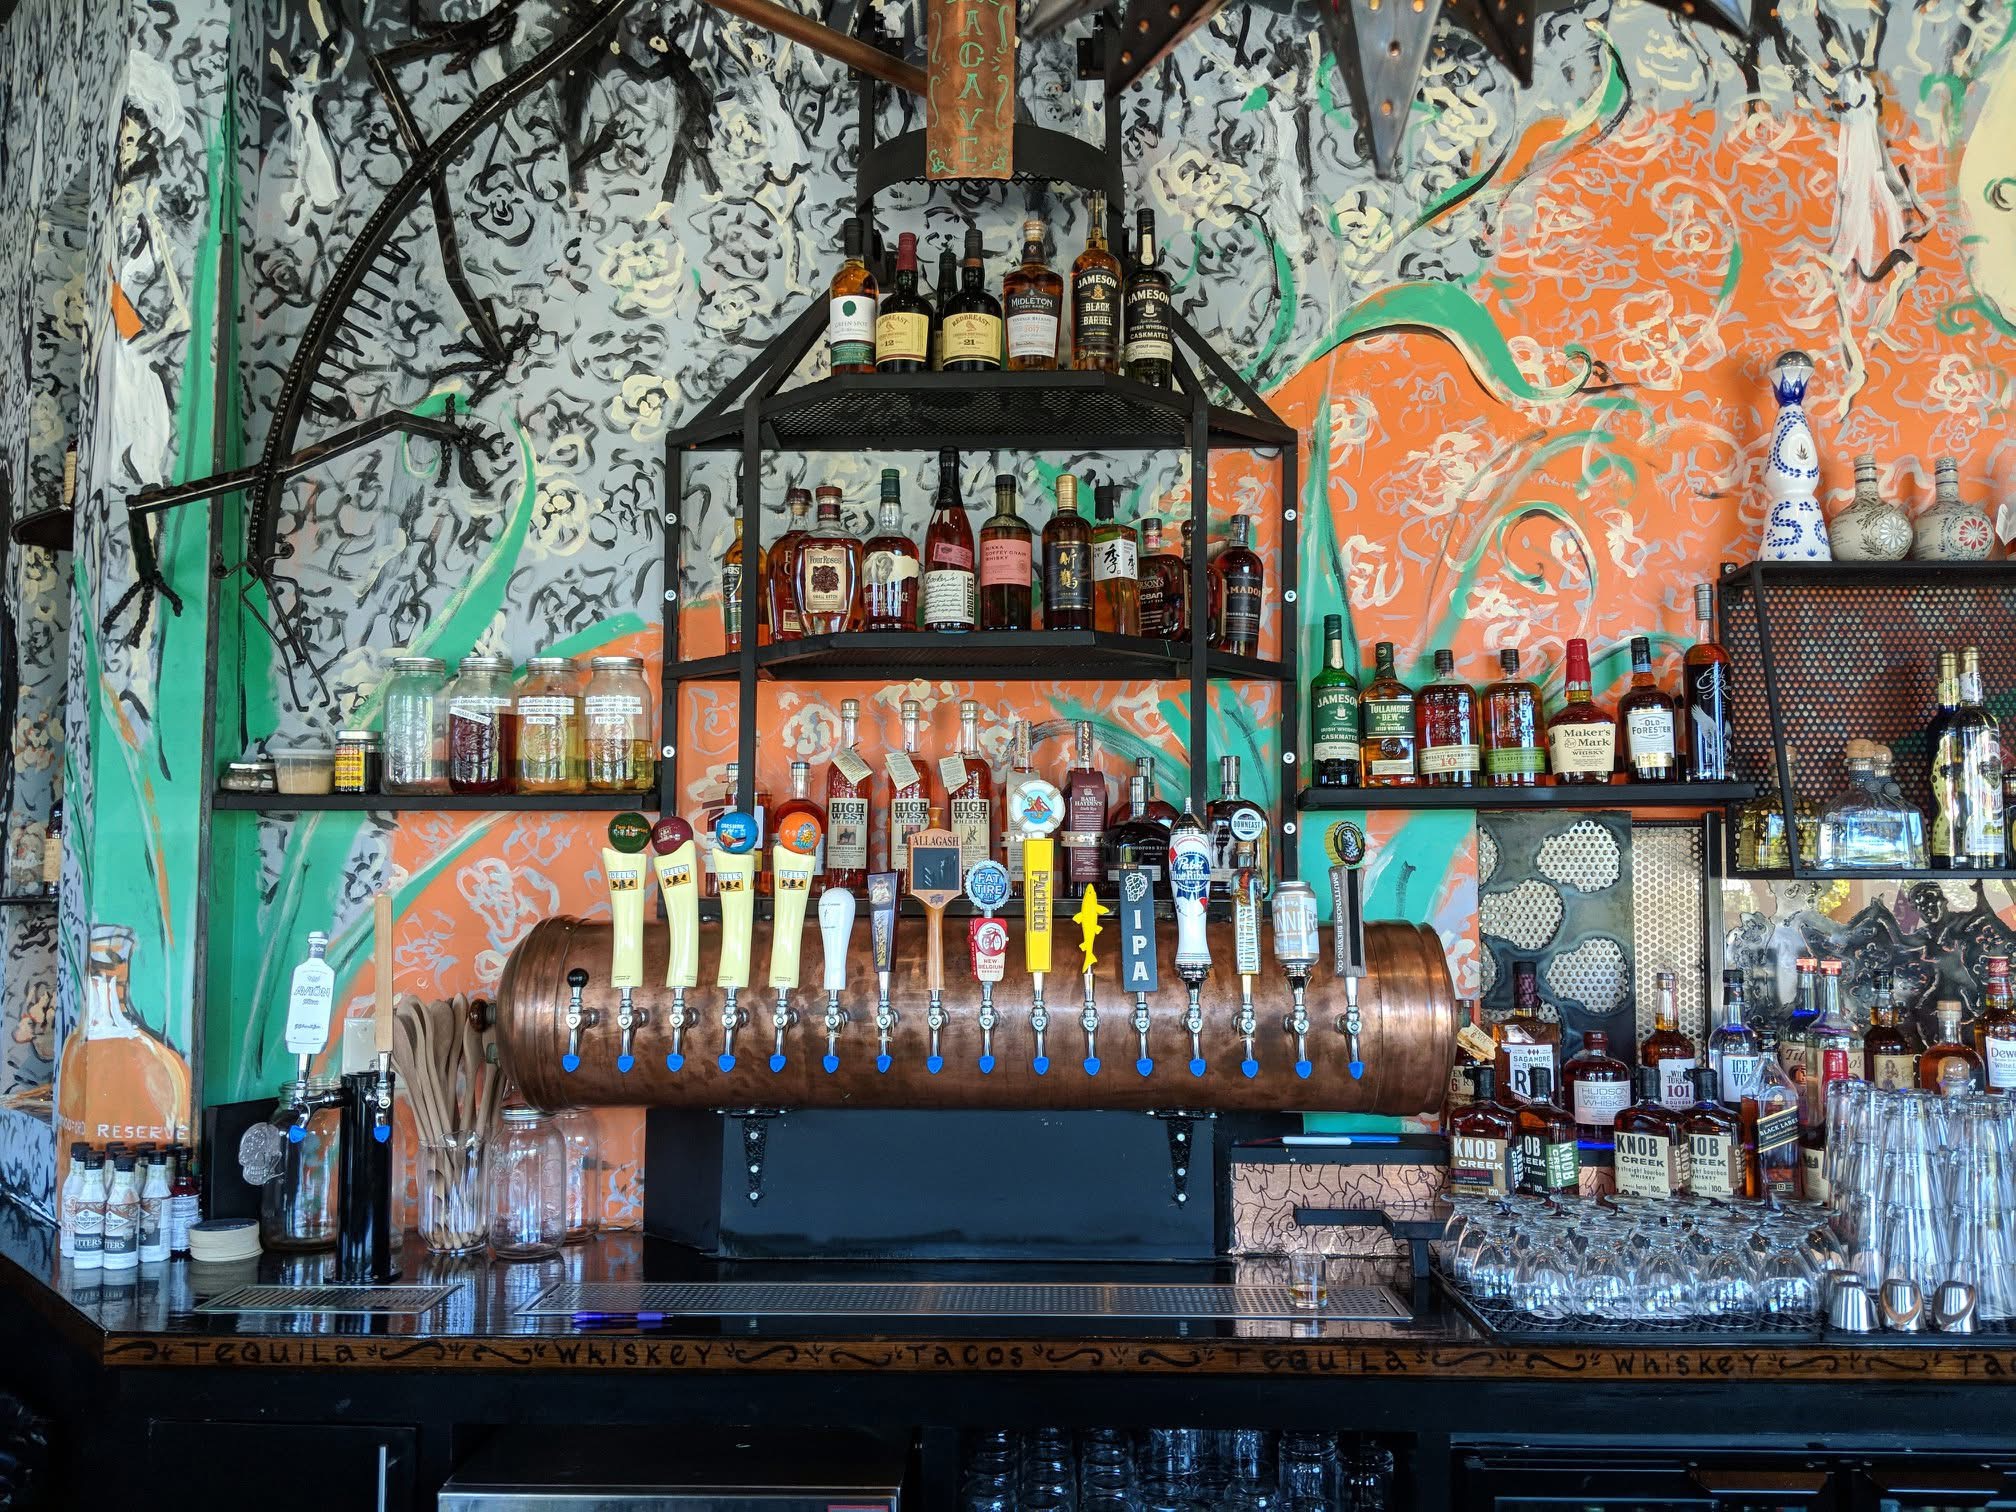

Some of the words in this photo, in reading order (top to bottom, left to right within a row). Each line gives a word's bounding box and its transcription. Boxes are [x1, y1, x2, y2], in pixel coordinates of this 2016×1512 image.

[957, 9, 985, 163] AGAVE
[1077, 274, 1118, 289] JAMESON
[1011, 297, 1053, 308] MIDLETON
[1128, 289, 1170, 306] JAMESON
[1085, 302, 1110, 312] BLACK
[951, 314, 991, 327] REDBREAST
[1083, 316, 1112, 326] BARREL
[1130, 332, 1169, 341] CASKMATES
[884, 339, 895, 347] 12
[1369, 703, 1410, 713] TULLAMORE
[1381, 713, 1399, 721] DEW
[1563, 729, 1611, 737] Maker's
[1632, 726, 1672, 735] FORESTER
[1578, 738, 1611, 747] Mark
[1440, 757, 1457, 767] 10
[831, 802, 865, 813] HIGH
[895, 801, 927, 812] HIGH
[954, 801, 987, 812] HIGH
[831, 812, 865, 820] WEST
[913, 836, 959, 847] ALLAGASH
[1177, 855, 1204, 870] Pabst
[977, 873, 1000, 883] FAT
[975, 884, 1002, 895] TIRE
[1032, 870, 1049, 932] PACIFICO
[1332, 872, 1343, 925] SMUTTYNOSE
[1132, 909, 1149, 982] IPA
[1336, 925, 1344, 959] BREWING
[293, 985, 332, 998] AVIÓN
[1513, 1055, 1551, 1063] SAGAMORE
[1732, 1060, 1749, 1073] ICE
[1451, 1078, 1458, 1092] 6
[1667, 1076, 1689, 1084] TURKE
[1581, 1087, 1628, 1096] HUDSON
[1667, 1085, 1690, 1098] 101
[1583, 1099, 1628, 1107] WHISKEY
[97, 1124, 190, 1140] RESERVE
[1760, 1125, 1780, 1136] BLACK
[1780, 1117, 1799, 1129] LABEL
[1453, 1137, 1497, 1160] KNOB
[1524, 1135, 1541, 1157] OB
[1617, 1134, 1658, 1158] KNOB
[1458, 1159, 1504, 1171] CREEK
[1559, 1143, 1575, 1180] KNOB
[1622, 1156, 1665, 1168] CREEK
[1690, 1158, 1726, 1167] REEK
[1552, 1149, 1562, 1188] CREEK
[1621, 1165, 1643, 1176] straight
[1643, 1168, 1665, 1177] bourbon
[1488, 1188, 1499, 1196] 120
[1534, 1184, 1543, 1192] 100
[1635, 1183, 1648, 1191] batch
[1650, 1185, 1660, 1193] 100
[1711, 1185, 1722, 1193] 100
